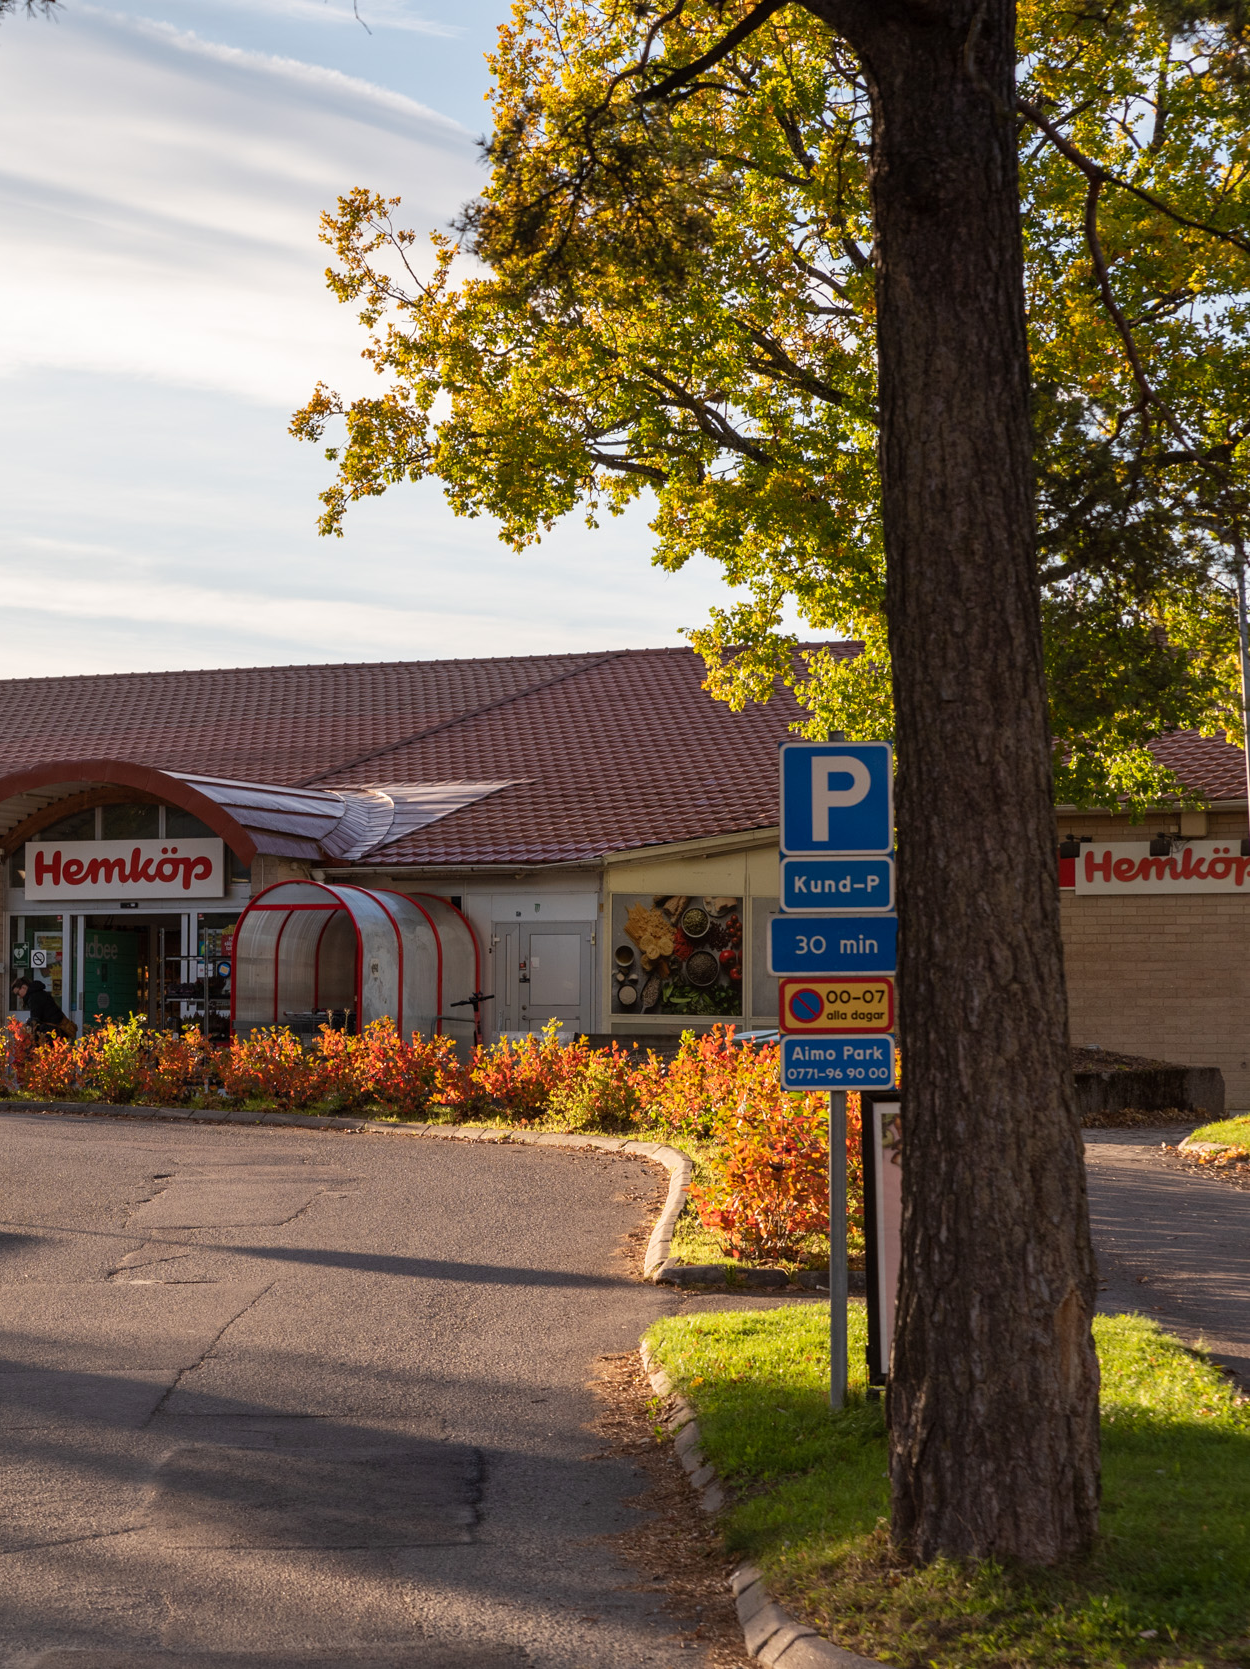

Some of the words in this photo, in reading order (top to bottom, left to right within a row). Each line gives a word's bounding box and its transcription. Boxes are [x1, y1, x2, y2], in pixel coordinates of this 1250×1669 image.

[811, 755, 871, 842] P
[34, 847, 213, 890] Hemköp
[794, 875, 880, 893] Kund-P
[795, 935, 826, 955] 30
[840, 934, 878, 954] min
[826, 989, 885, 1004] 00-07
[826, 1010, 847, 1021] alla
[851, 1010, 885, 1023] dagar
[792, 1046, 836, 1061] Aimo
[843, 1046, 883, 1060] Park
[787, 1068, 843, 1080] 0771-96
[846, 1067, 865, 1079] 90
[868, 1067, 888, 1079] 00
